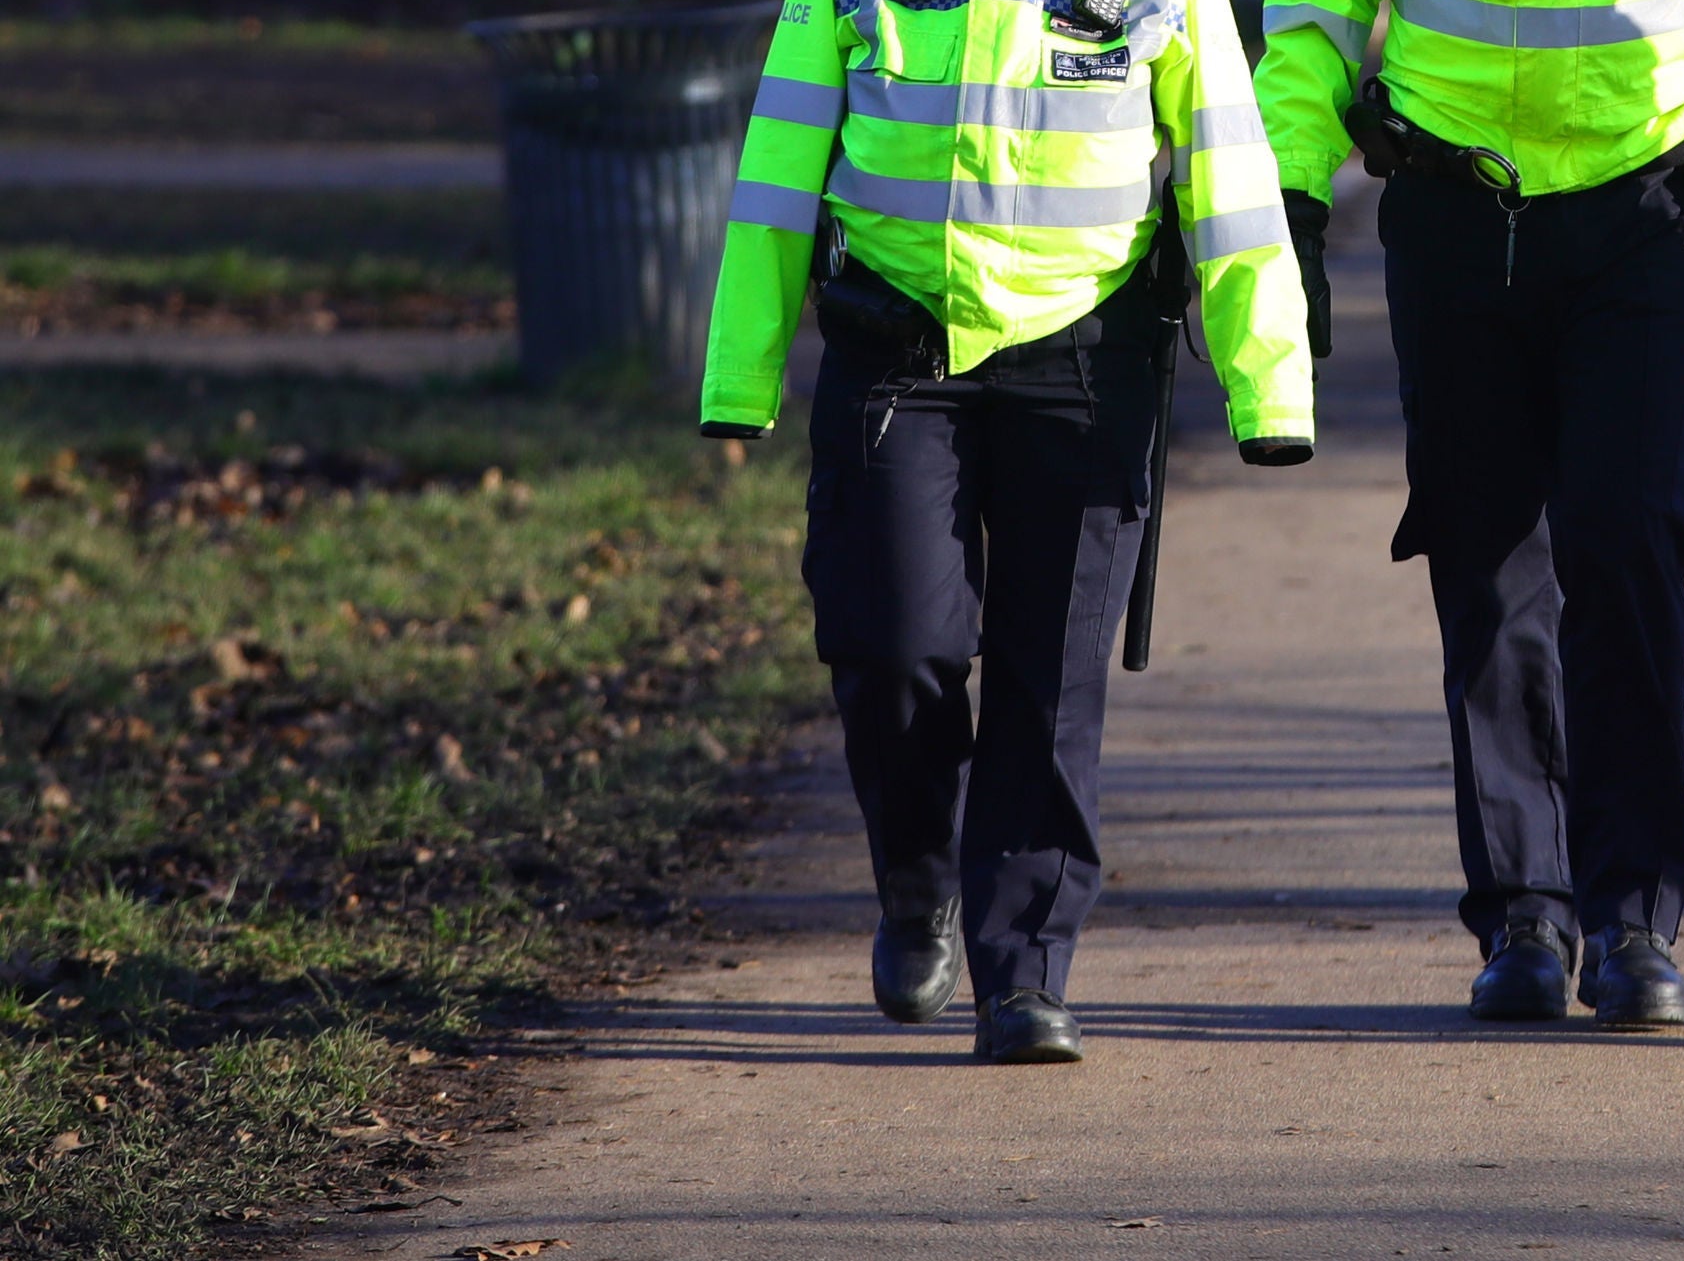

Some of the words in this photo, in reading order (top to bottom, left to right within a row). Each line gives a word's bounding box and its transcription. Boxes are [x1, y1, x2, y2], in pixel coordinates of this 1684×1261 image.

[1085, 57, 1116, 66] POLICE
[1056, 69, 1088, 78] POLICE
[1090, 67, 1127, 77] OFFICER
